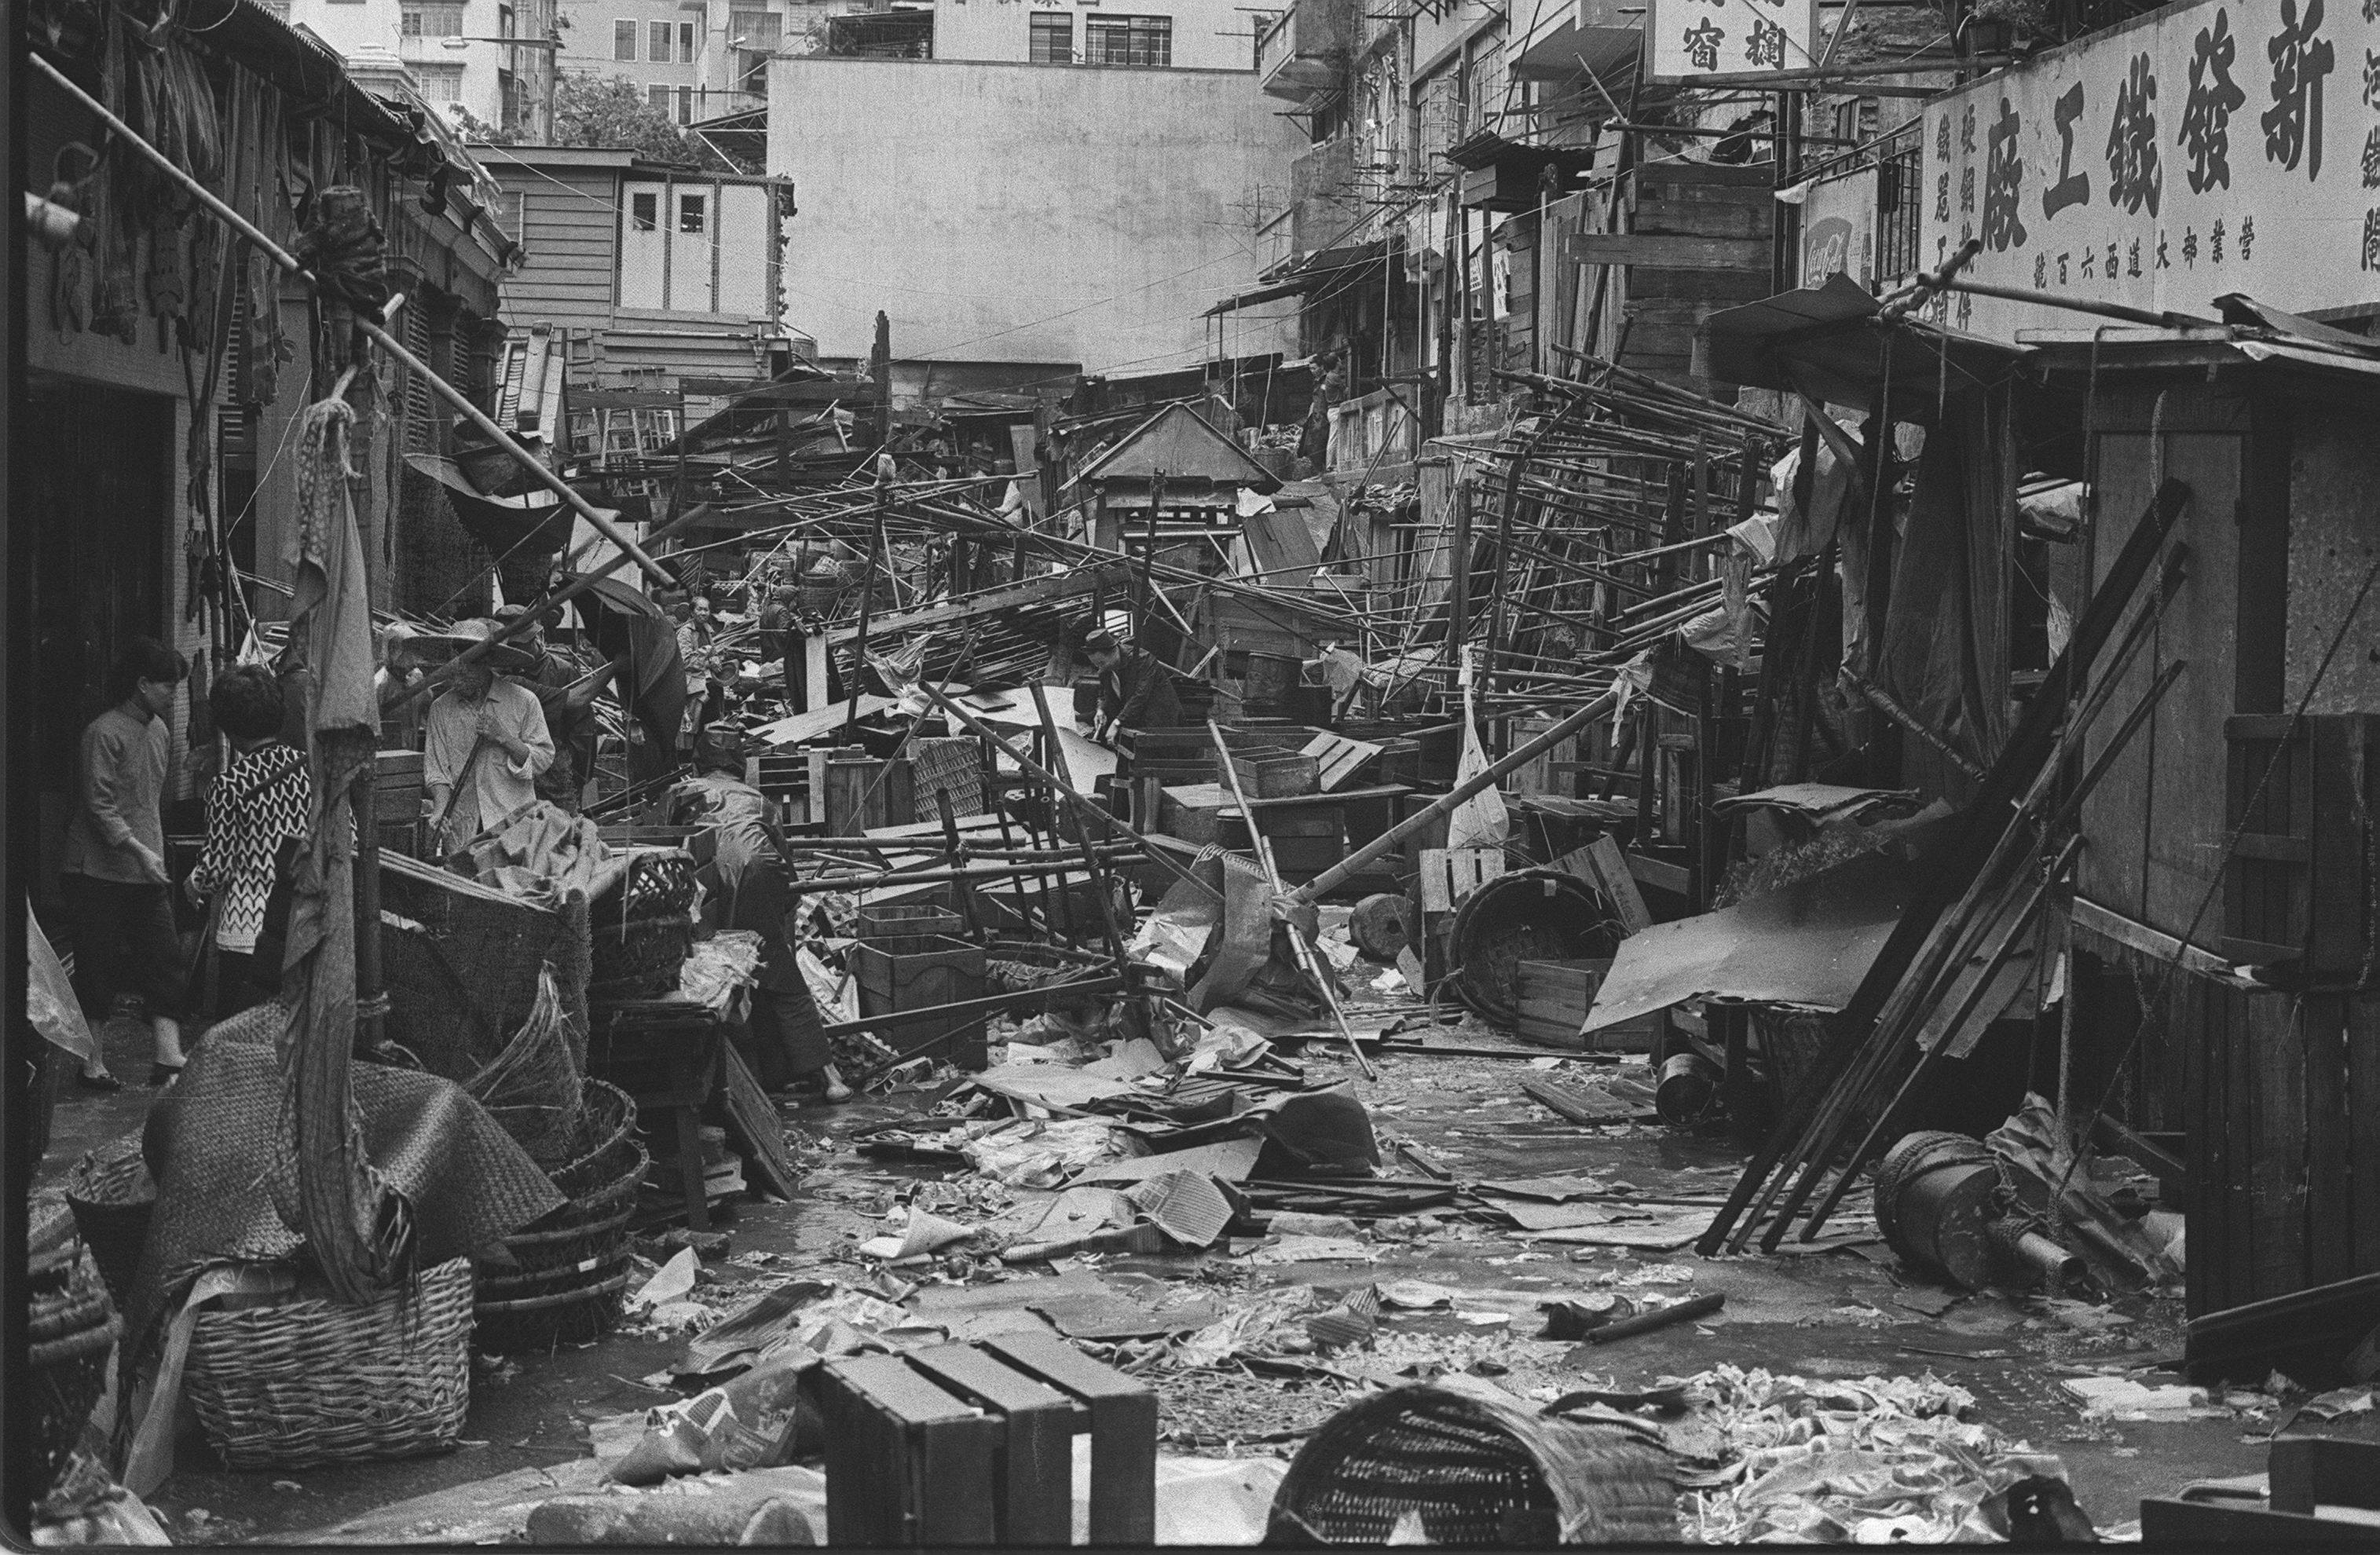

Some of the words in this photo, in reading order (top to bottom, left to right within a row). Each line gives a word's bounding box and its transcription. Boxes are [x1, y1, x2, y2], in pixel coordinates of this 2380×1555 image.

[1682, 0, 1726, 71] 窗
[1745, 0, 1787, 71] 欄
[1979, 0, 2335, 254] 新發鐵工廠
[2034, 214, 2255, 290] 營業部大道西六百號
